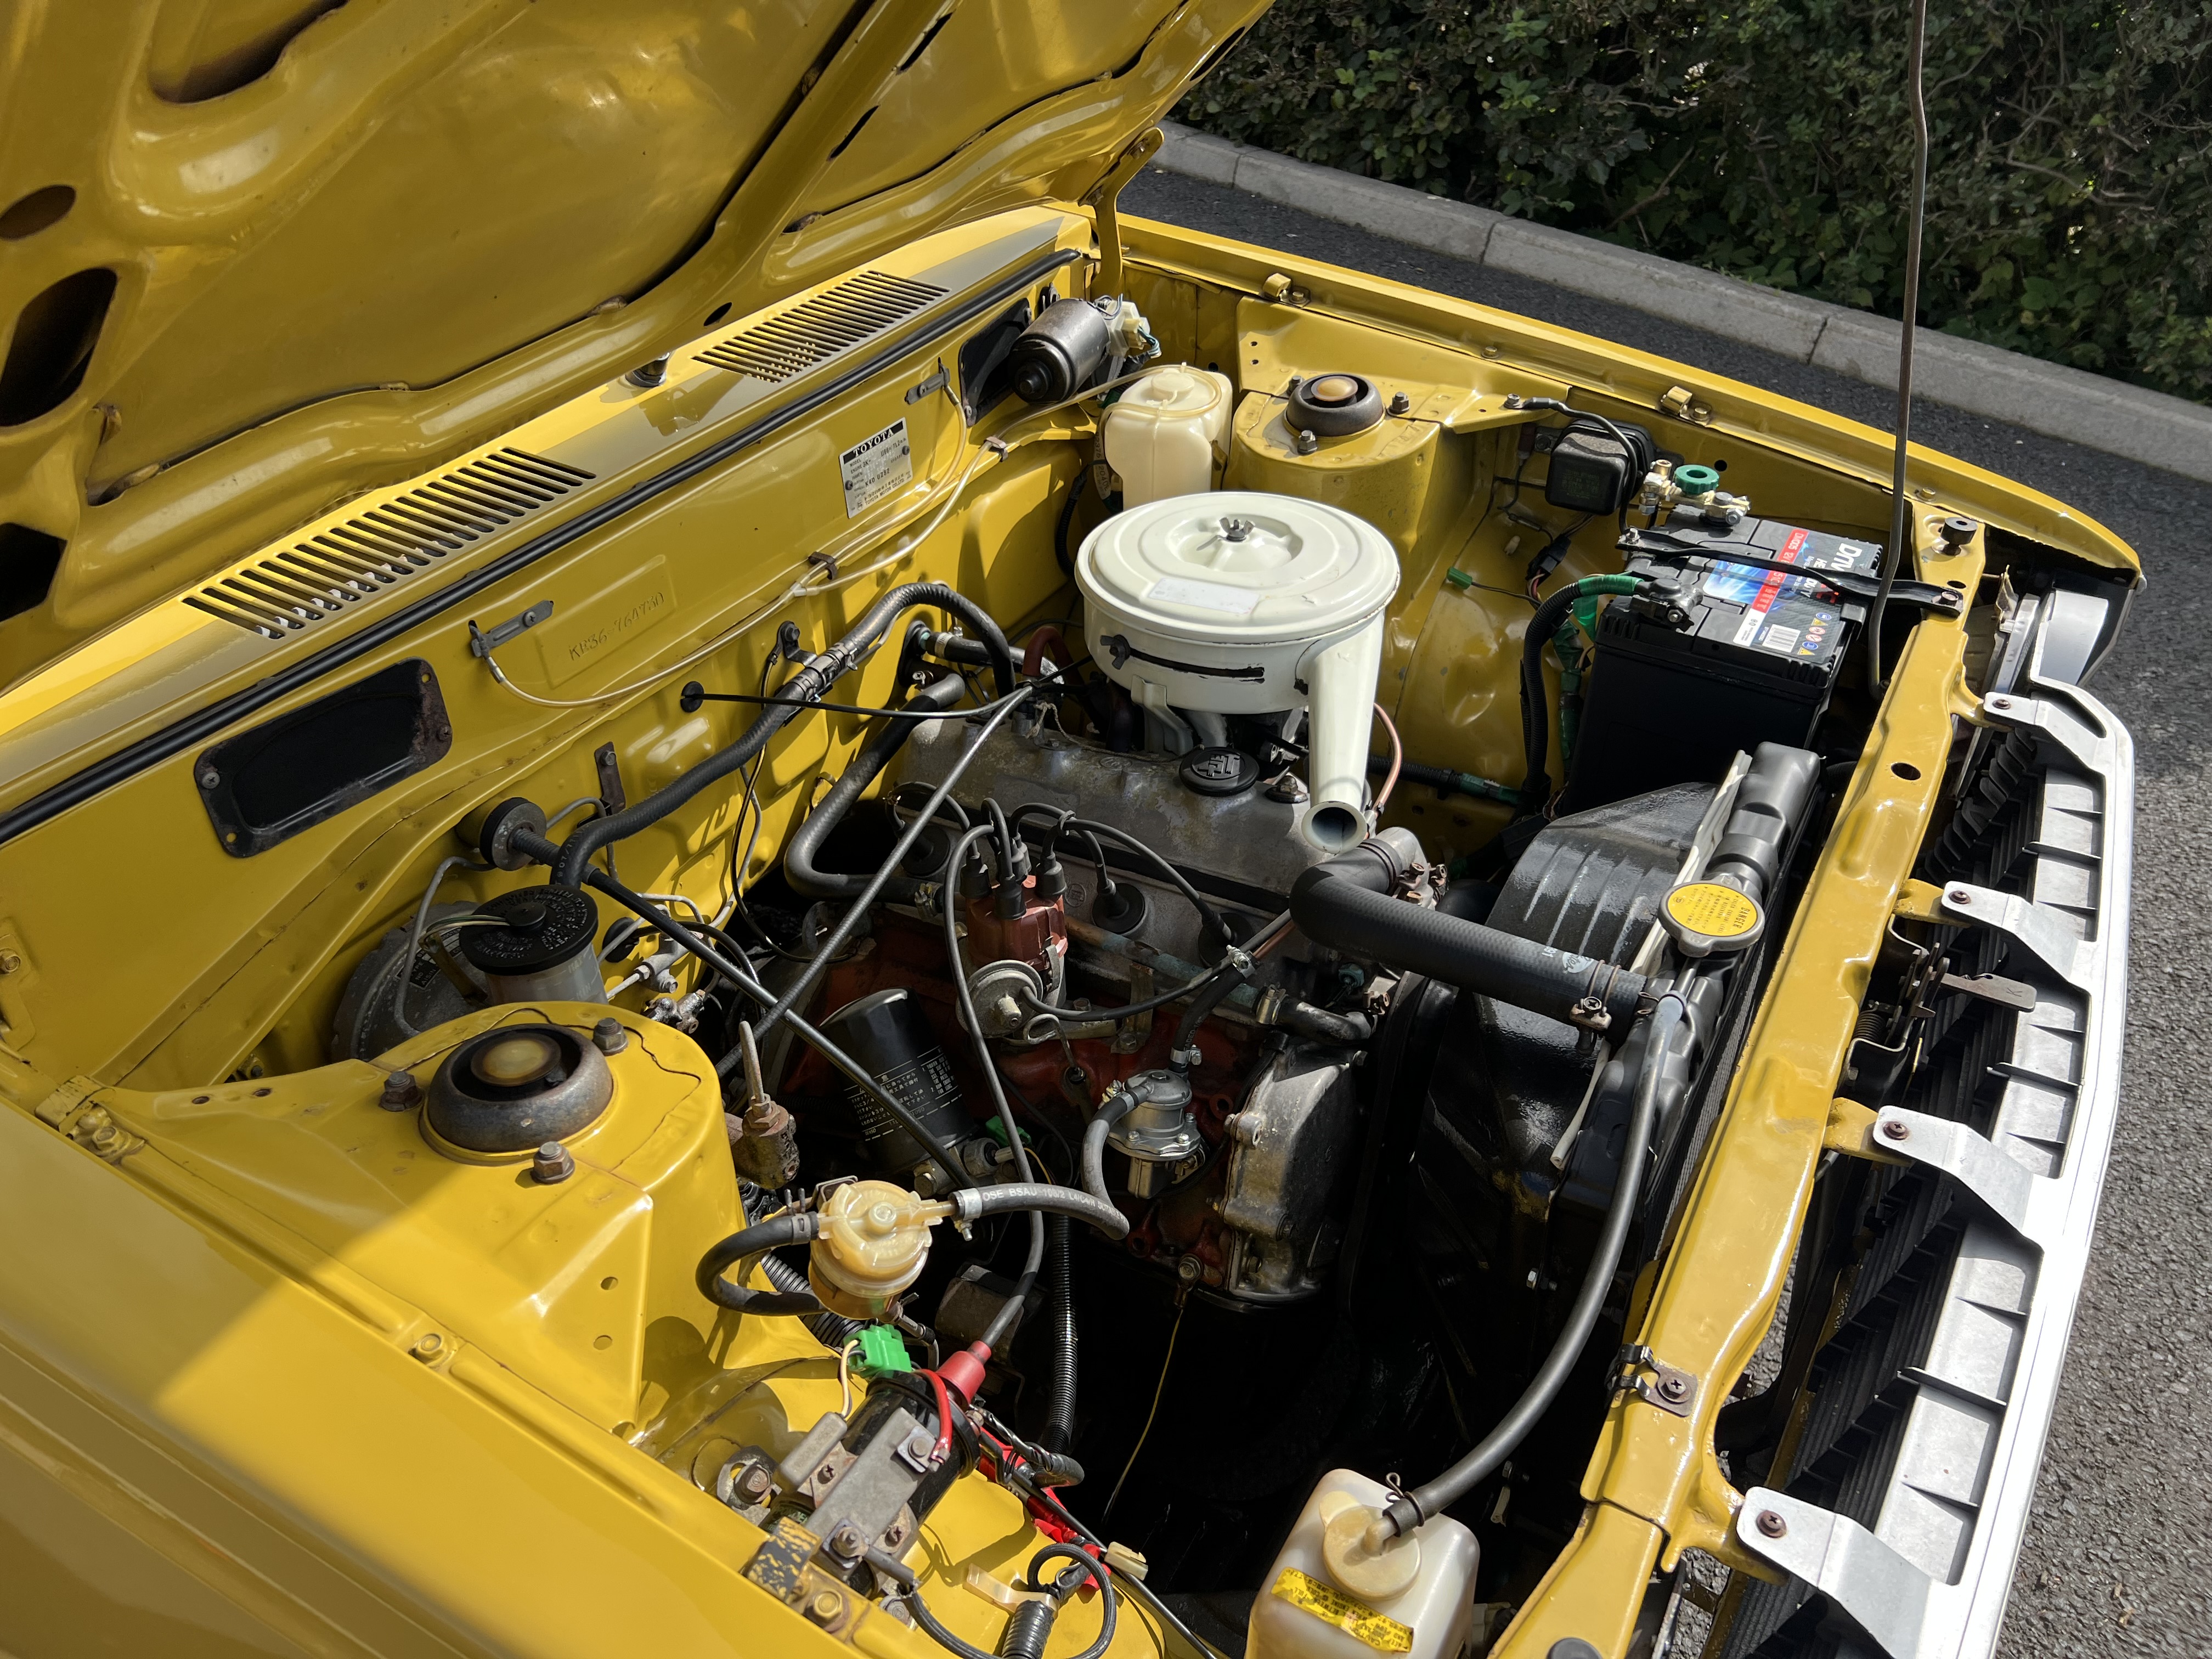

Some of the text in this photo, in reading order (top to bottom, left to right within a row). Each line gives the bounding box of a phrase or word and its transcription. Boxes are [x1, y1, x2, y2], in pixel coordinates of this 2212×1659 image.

[853, 428, 894, 458] TOYOTA
[1733, 907, 1751, 929] DANGER
[983, 1189, 1005, 1201] OSE
[1009, 1187, 1039, 1197] BSAU
